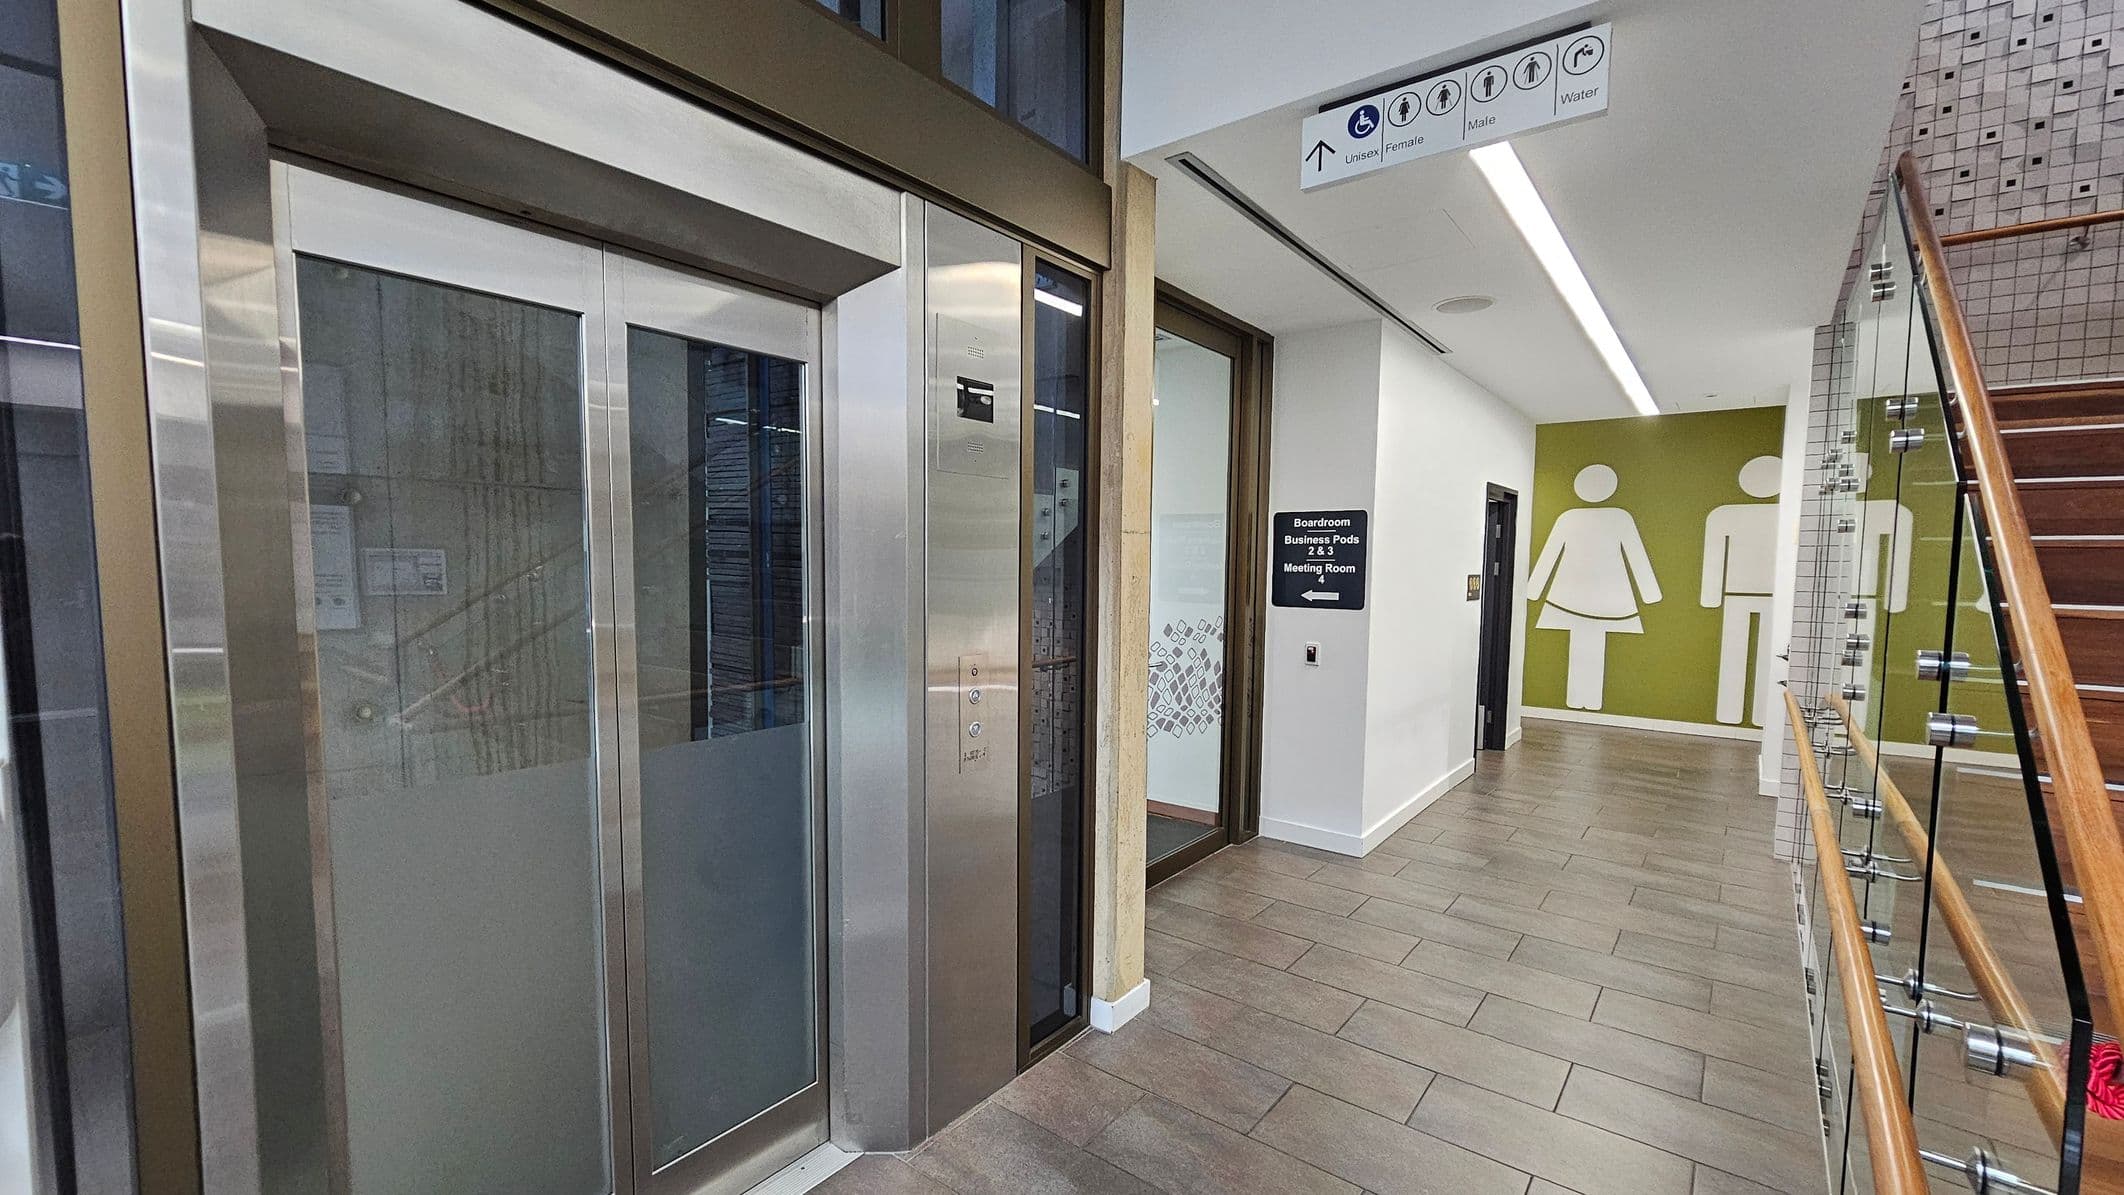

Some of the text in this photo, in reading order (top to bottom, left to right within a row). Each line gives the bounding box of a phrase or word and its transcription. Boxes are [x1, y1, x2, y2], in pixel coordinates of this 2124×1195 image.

[1560, 86, 1599, 105] Water
[1467, 115, 1496, 131] Male
[1385, 136, 1424, 154] Female
[1345, 149, 1379, 164] Unisex
[1294, 518, 1351, 528] Boardroom
[1284, 535, 1360, 544] Business Pods
[1308, 547, 1334, 556] 2 & 3
[1284, 563, 1356, 574] Meeting Room
[1318, 575, 1325, 584] 4
